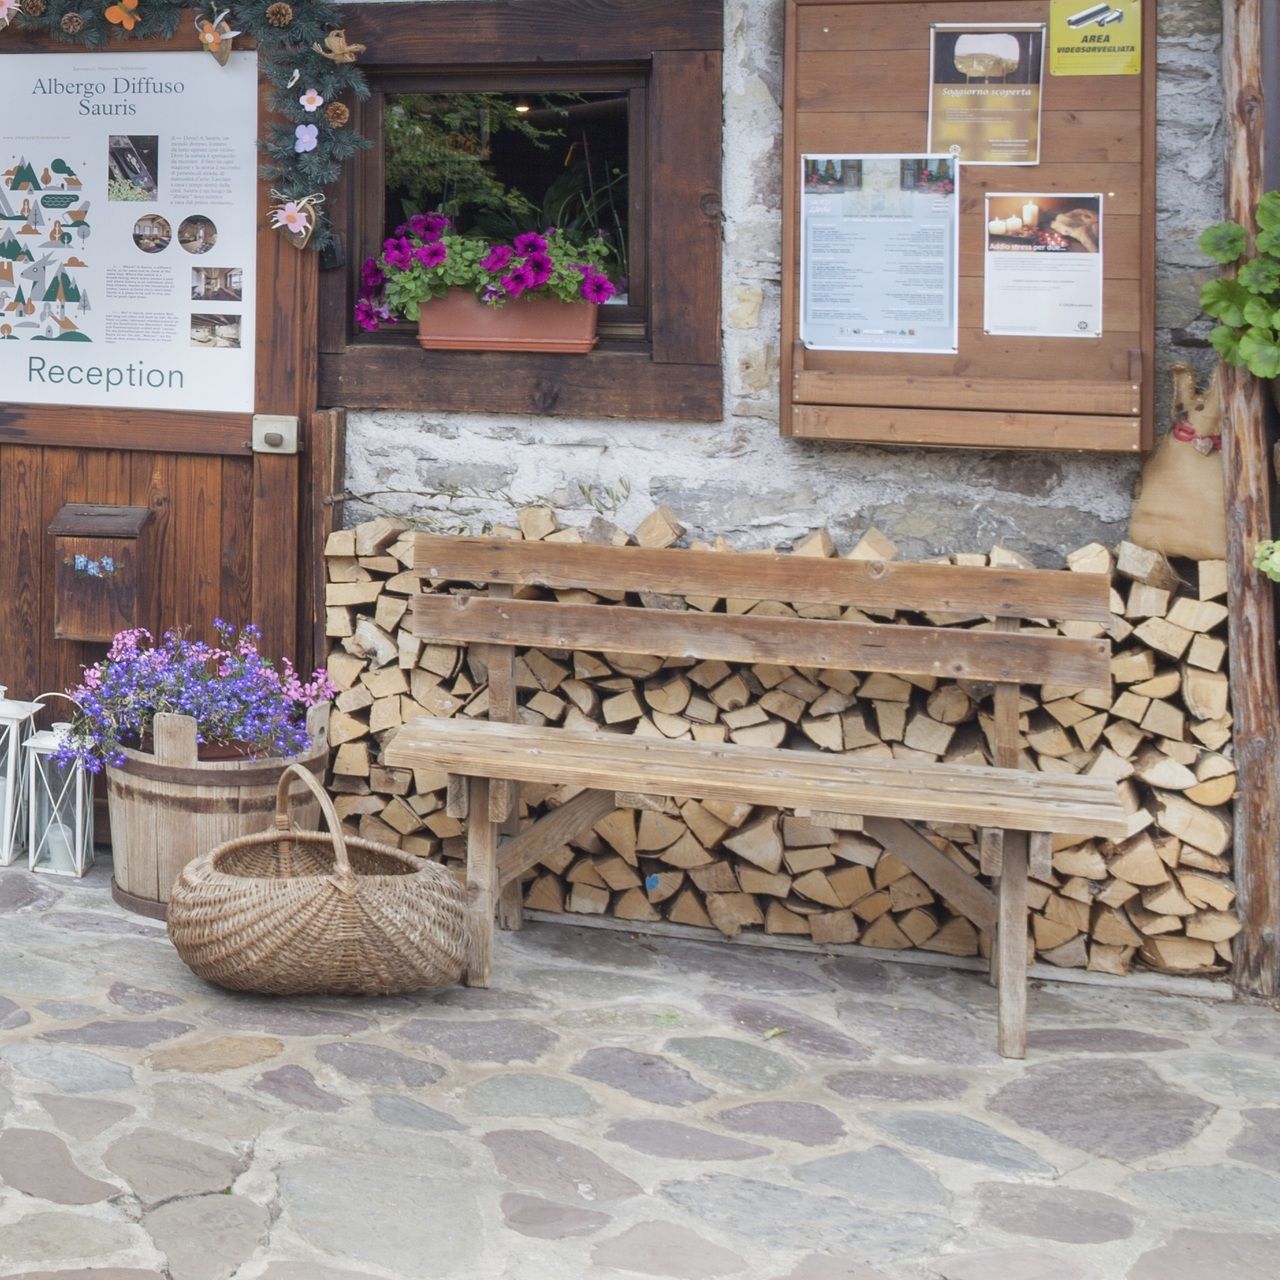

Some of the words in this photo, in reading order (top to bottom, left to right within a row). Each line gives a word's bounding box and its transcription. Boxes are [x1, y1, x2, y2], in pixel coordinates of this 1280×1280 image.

[1080, 35, 1111, 44] AREA
[1057, 45, 1136, 54] VIDEOSORVEGLIATA
[32, 78, 106, 98] Albergo
[112, 76, 185, 95] Diffuso
[941, 87, 989, 98] Soggiorno
[991, 87, 1032, 98] scoperta
[78, 98, 137, 116] Sauris
[28, 356, 184, 392] Reception
